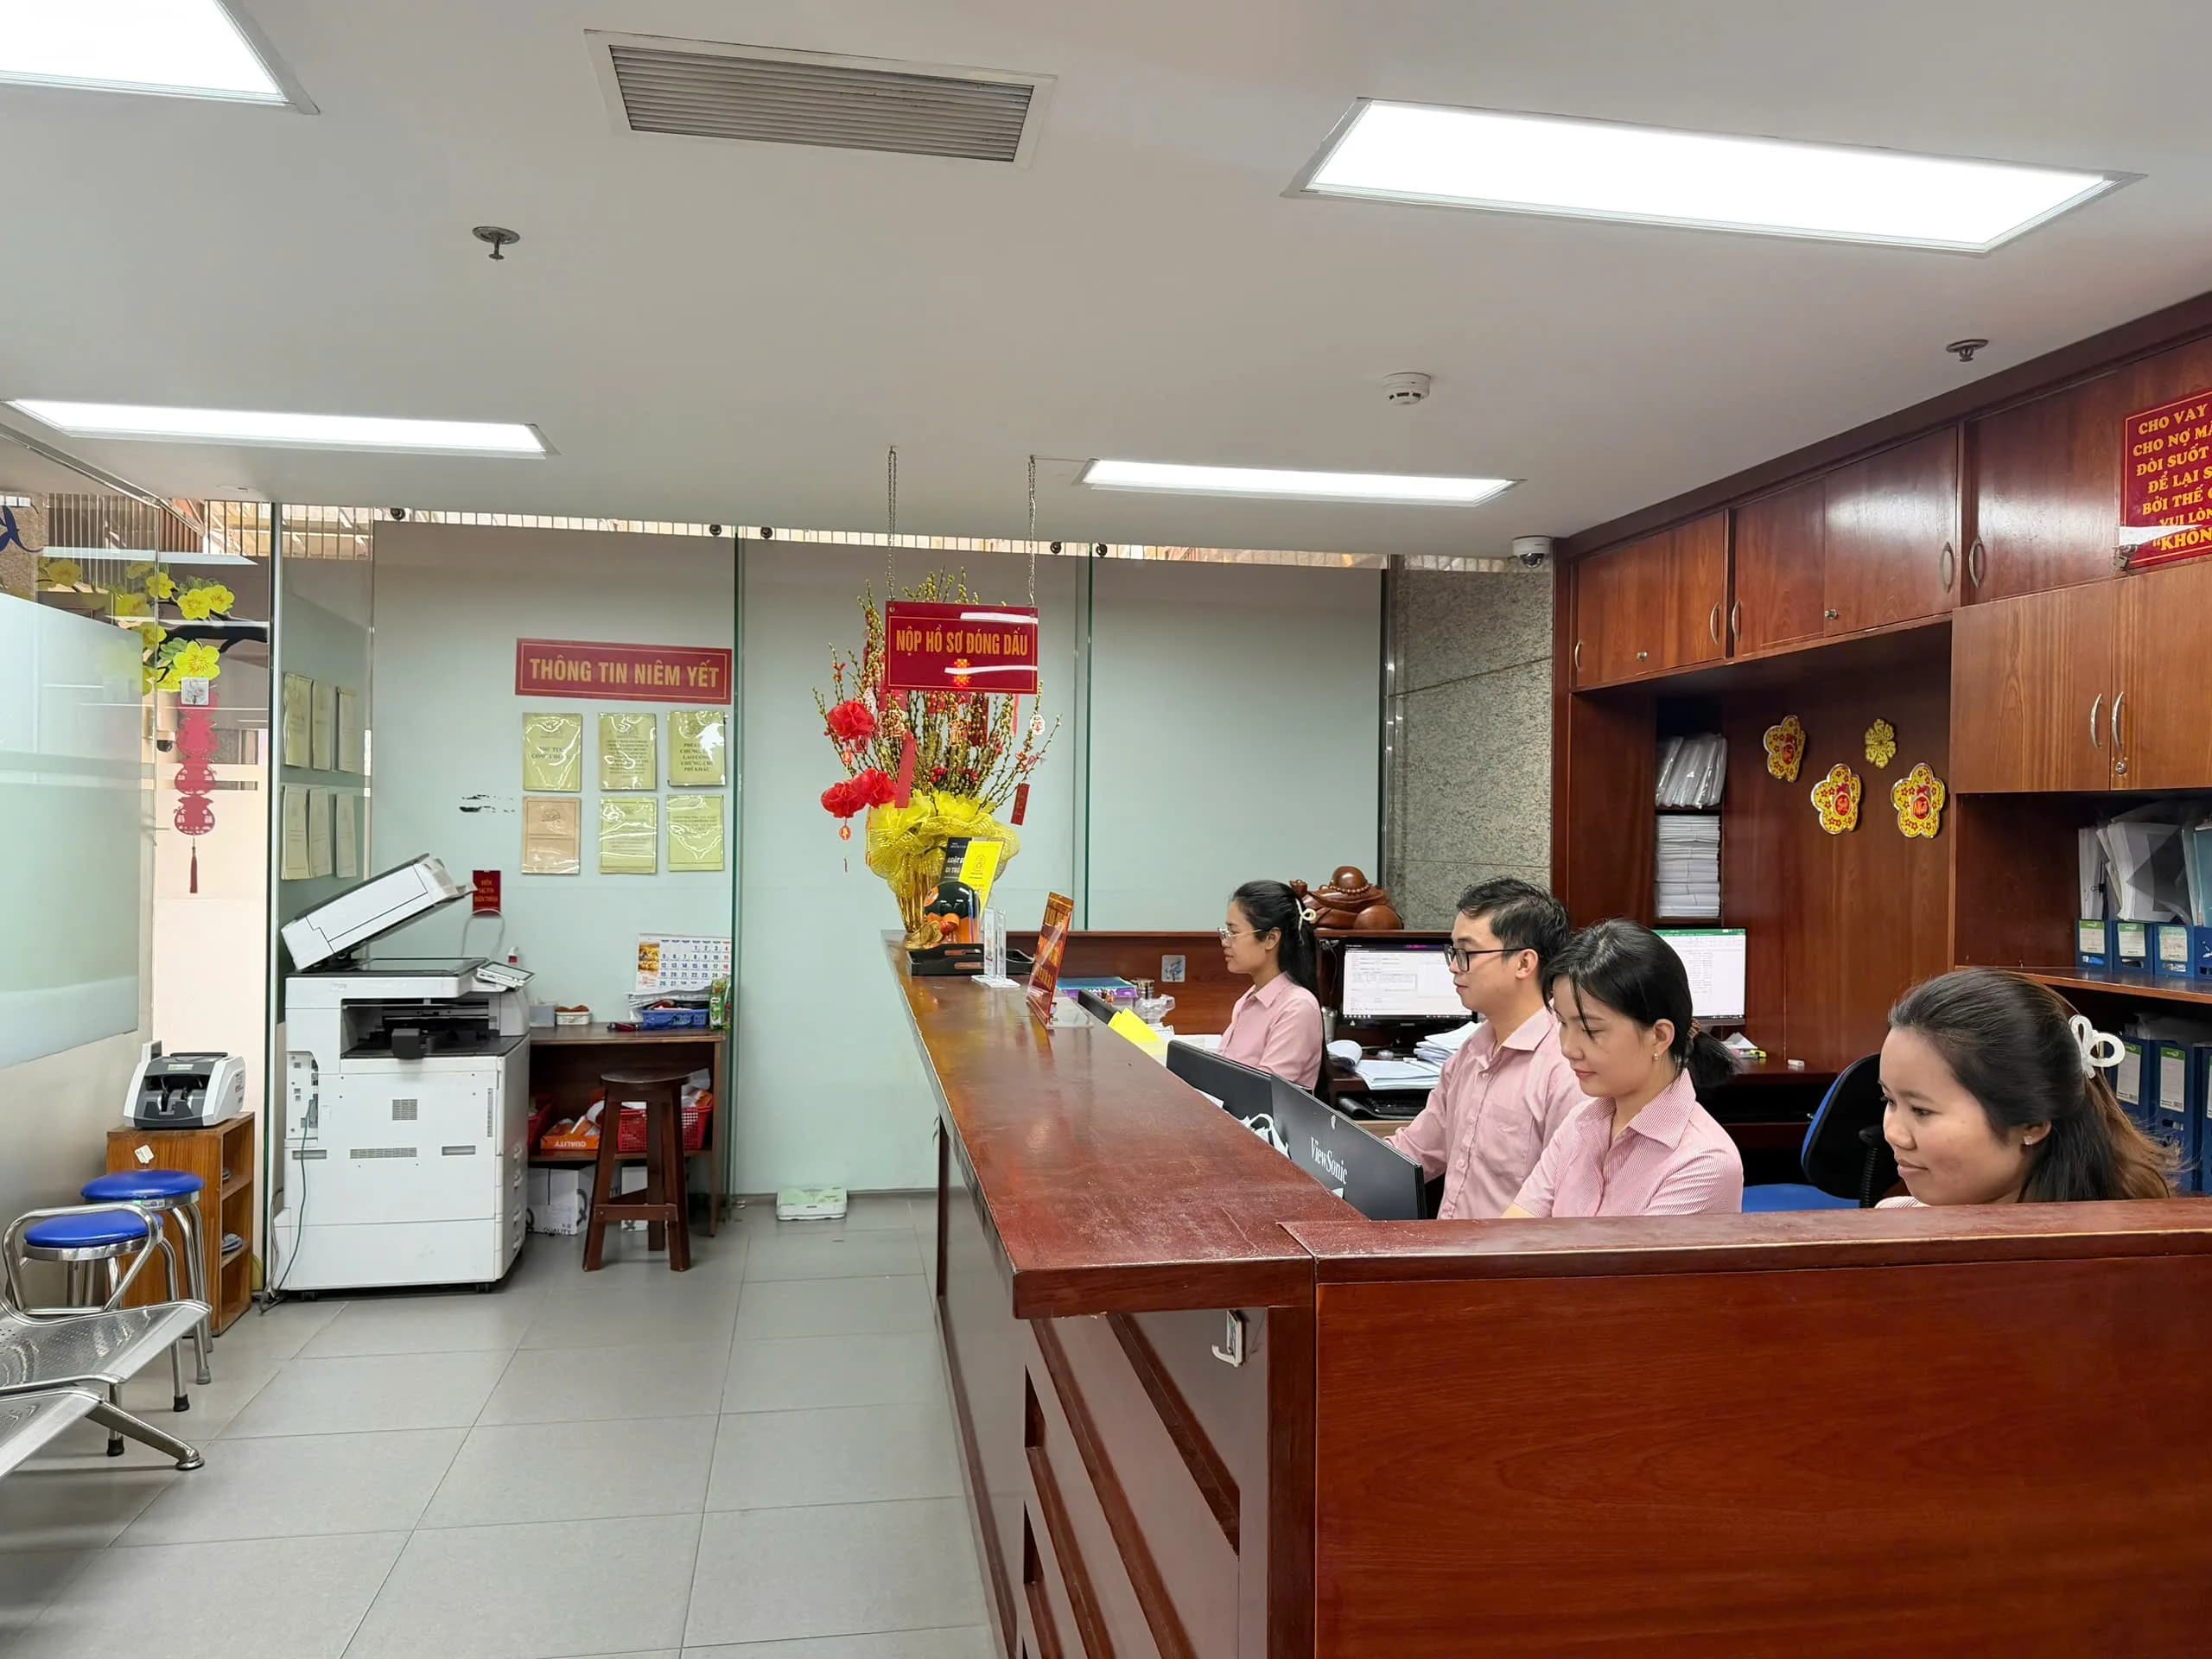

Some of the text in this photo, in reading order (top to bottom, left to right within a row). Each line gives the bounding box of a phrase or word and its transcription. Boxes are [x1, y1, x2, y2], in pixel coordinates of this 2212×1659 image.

[2139, 403, 2208, 435] CHO VAY
[2133, 438, 2164, 456] CHO
[2168, 428, 2190, 447] NỢ
[2136, 443, 2209, 476] ĐÒI SUỐT
[2172, 469, 2199, 488] LẠI
[2143, 495, 2168, 516] BỞI
[2172, 484, 2203, 507] THẾ
[896, 624, 1028, 656] NỘP HỒ SƠ ĐÓNG DẤU
[530, 655, 720, 688] THÔNG TIN NIÊM YẾT
[1310, 1136, 1347, 1185] ViewSonic
